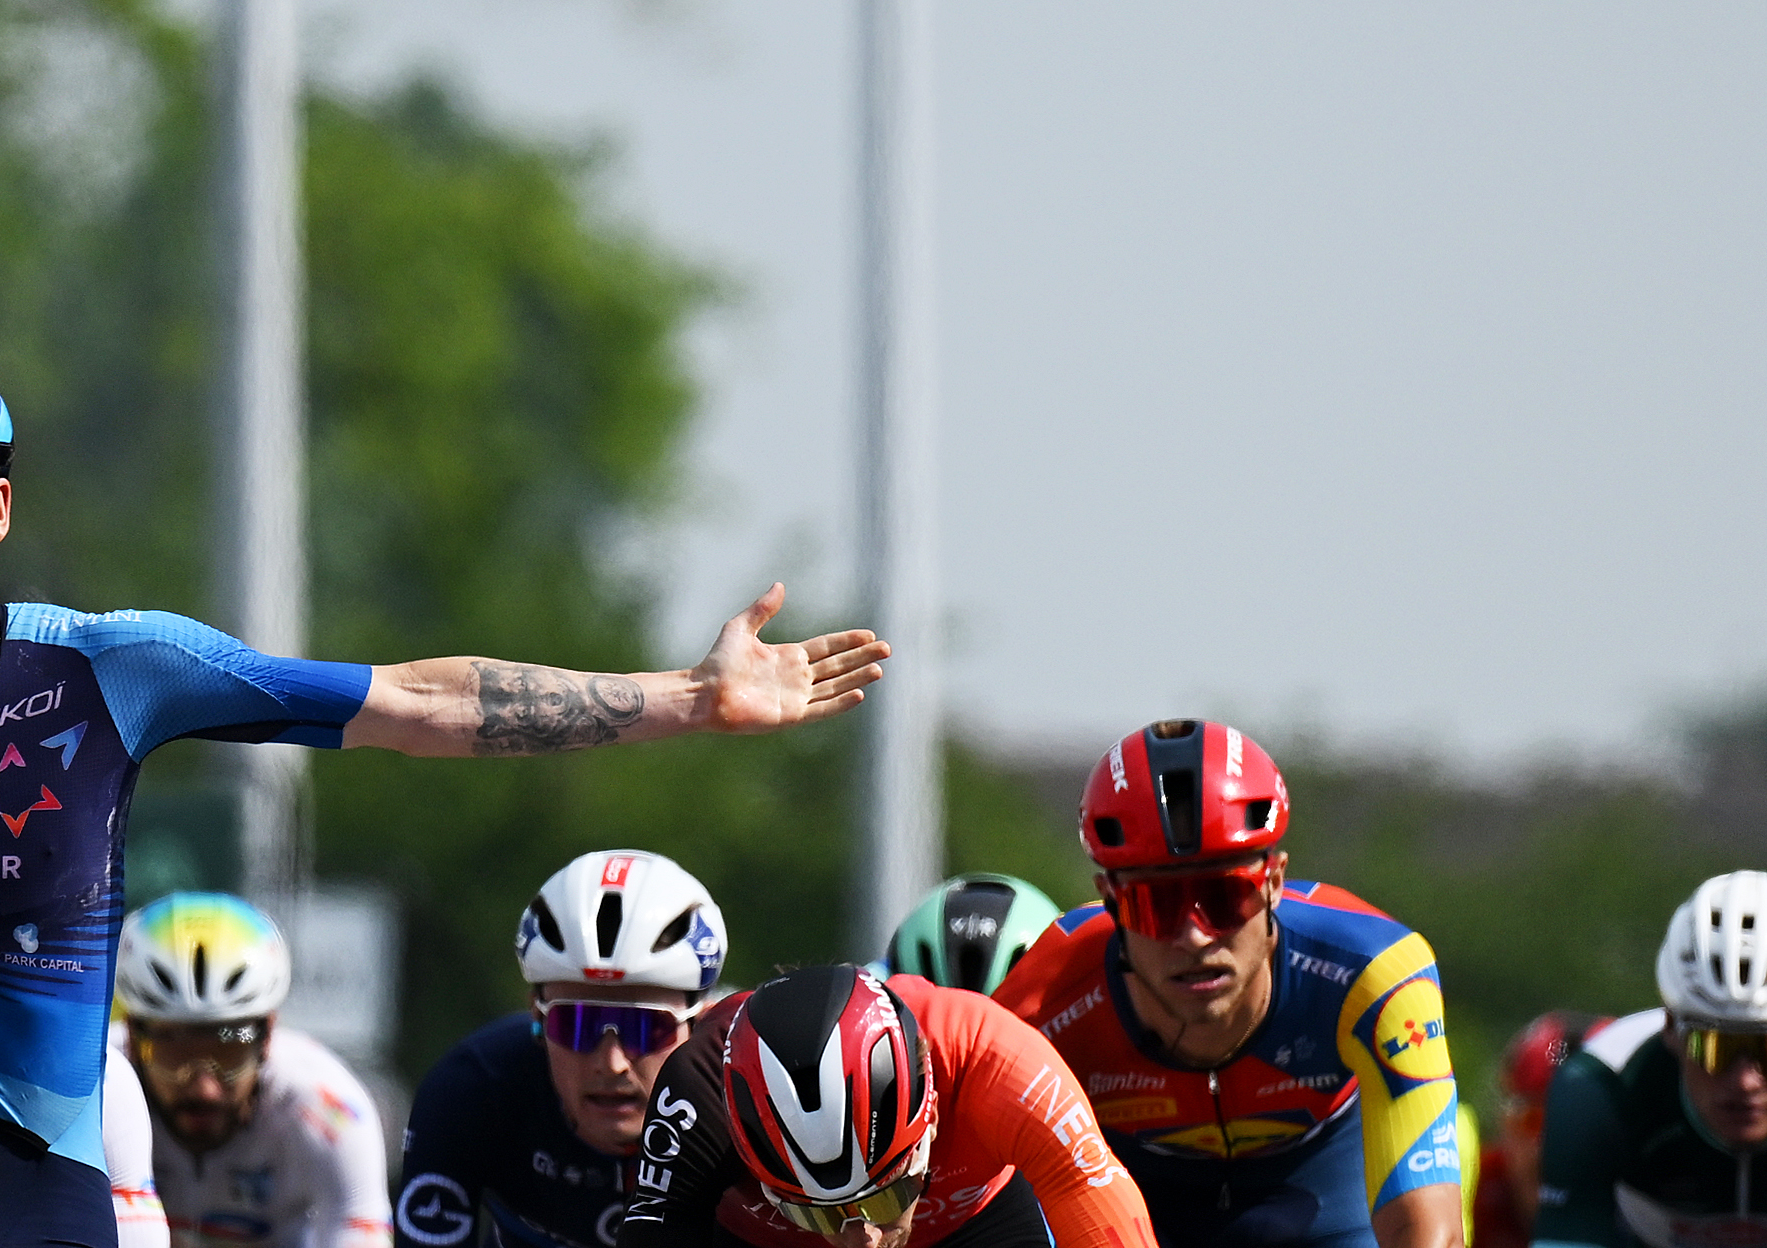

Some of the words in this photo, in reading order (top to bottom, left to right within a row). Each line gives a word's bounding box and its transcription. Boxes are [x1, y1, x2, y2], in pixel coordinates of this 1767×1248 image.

[3, 951, 37, 968] PARK
[39, 956, 85, 974] CAPITAL
[1288, 948, 1357, 988] TREK
[1038, 984, 1105, 1040] TREK
[1018, 1063, 1131, 1190] INEOS
[624, 1085, 699, 1225] INEOS
